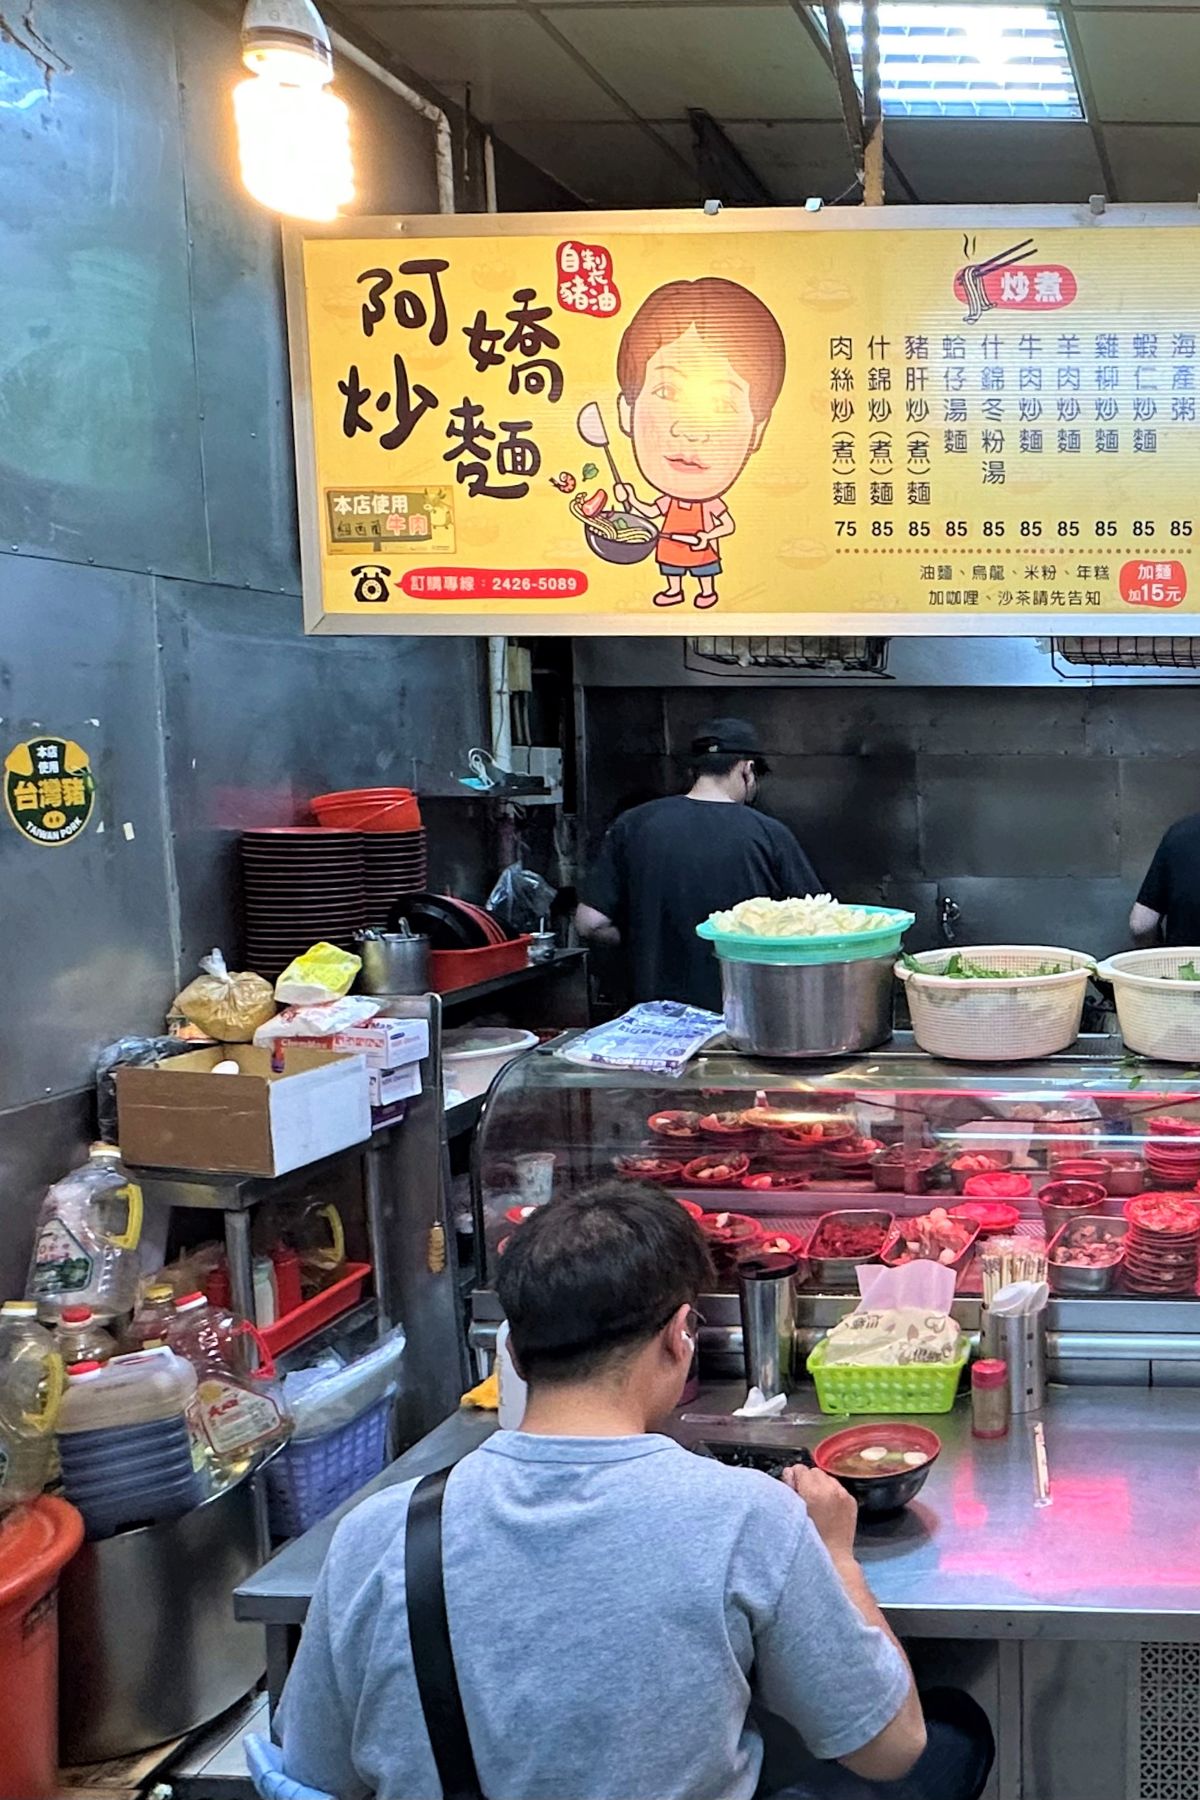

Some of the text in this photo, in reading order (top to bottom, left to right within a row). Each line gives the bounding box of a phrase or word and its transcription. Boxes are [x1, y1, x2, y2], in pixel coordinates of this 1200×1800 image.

[560, 245, 608, 286] 自製
[559, 280, 616, 313] 豬油
[1001, 272, 1063, 302] 炒煮
[357, 259, 565, 403] 阿嬌
[942, 335, 968, 454] 蛤仔湯麵
[1018, 335, 1043, 454] 牛肉炒麵
[1056, 333, 1081, 454] 羊肉炒麵
[1094, 333, 1120, 454] 雞柳炒麵
[1132, 333, 1158, 454] 蝦仁炒麵
[1170, 333, 1197, 422] 海產粥
[338, 354, 541, 499] 炒麵
[980, 335, 1006, 485] 什錦冬粉湯
[333, 495, 408, 515] 本店使用
[386, 513, 428, 536] 牛肉
[834, 521, 1193, 537] 75 85 85 85 85 85 85 85 85 85
[1138, 564, 1172, 580] 加麵
[1128, 585, 1181, 603] 加15元
[14, 778, 85, 811] 台灣豬
[26, 817, 82, 840] TAIWAN PORK
